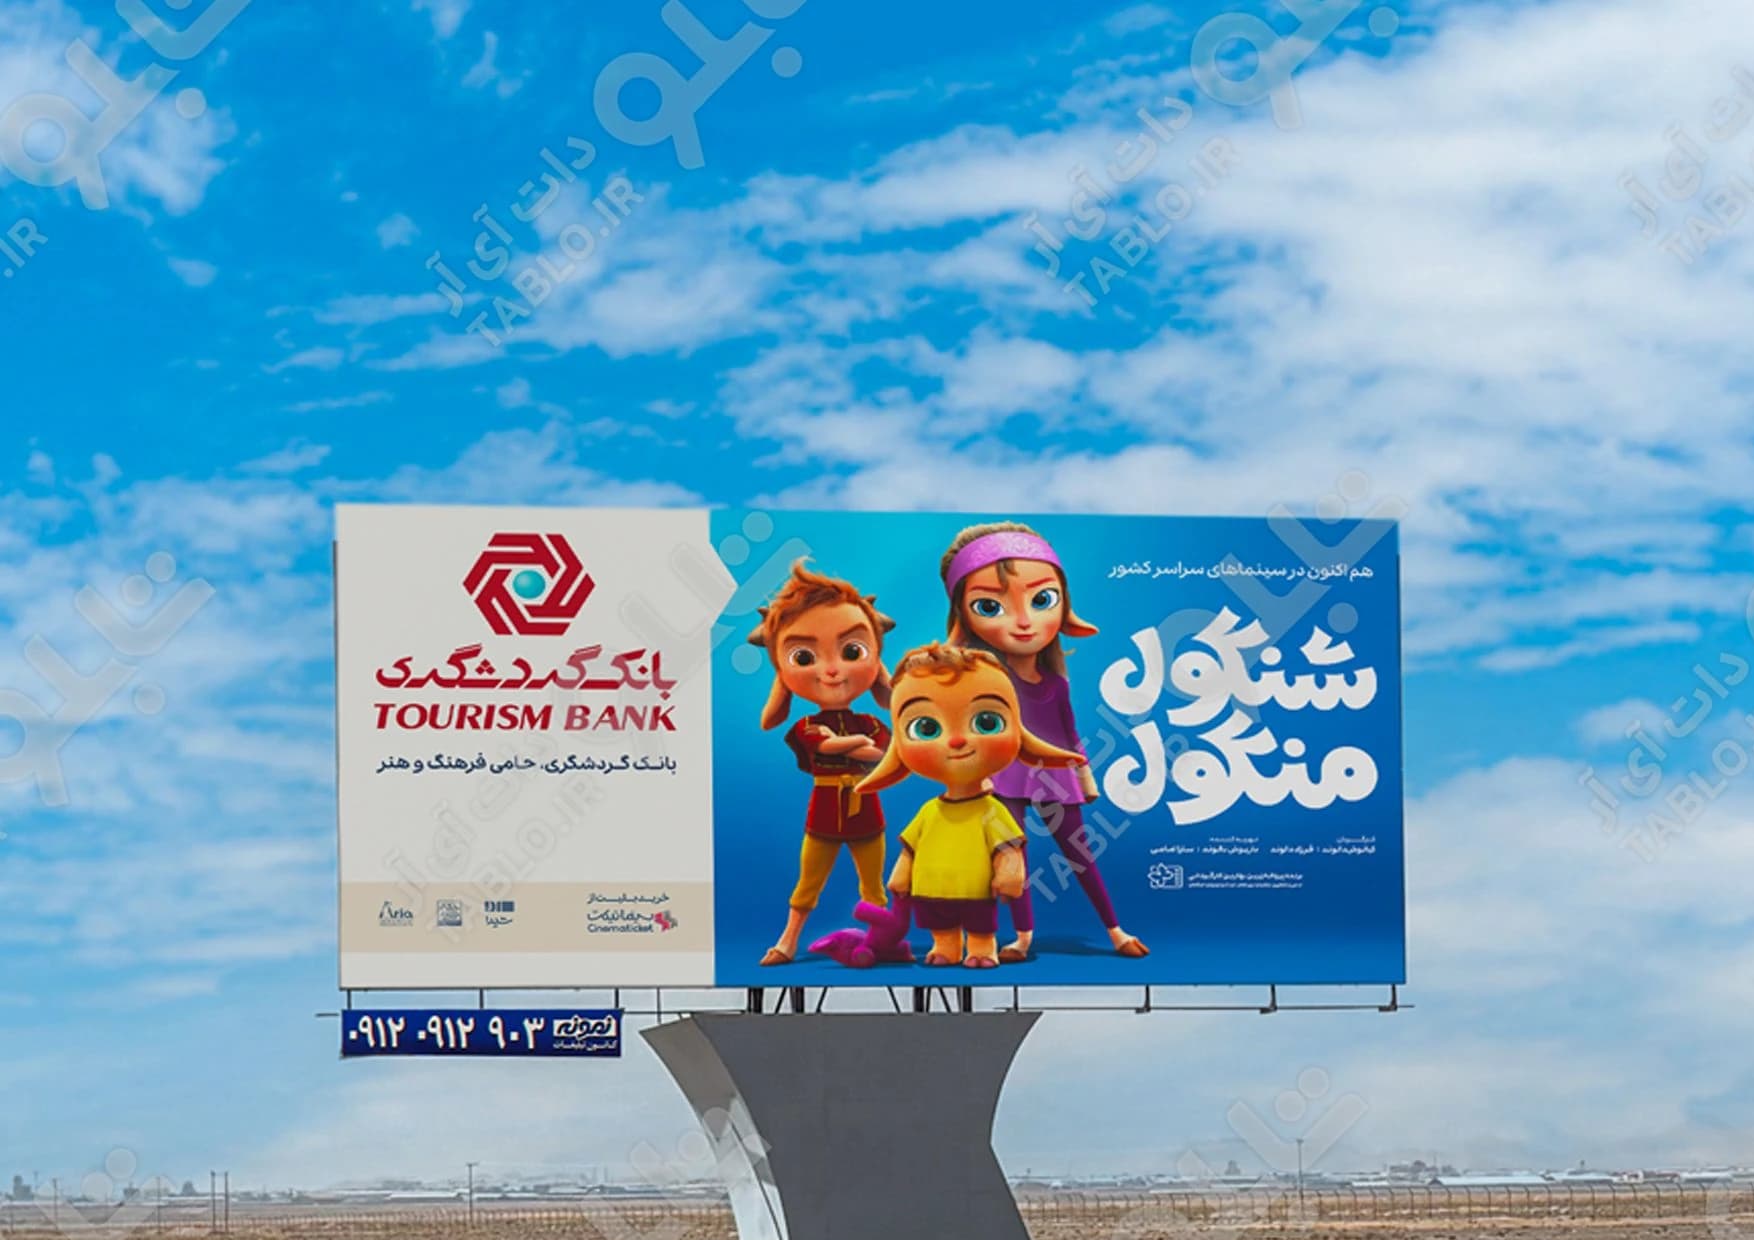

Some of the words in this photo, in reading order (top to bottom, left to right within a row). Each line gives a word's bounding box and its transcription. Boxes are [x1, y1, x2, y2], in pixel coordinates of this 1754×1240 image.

[1107, 560, 1151, 579] کشور
[1153, 561, 1204, 580] سراسر
[1207, 561, 1287, 580] سینماهای
[1287, 565, 1306, 581] در
[1307, 561, 1348, 581] اکنون
[1349, 562, 1374, 581] هم
[376, 643, 602, 690] گردشگری
[579, 648, 678, 700] بانک
[1099, 605, 1378, 727] شنگول
[374, 703, 552, 731] TOURISM
[563, 705, 677, 731] BANK
[376, 755, 410, 773] هنر
[413, 761, 424, 774] و
[426, 752, 486, 774] فرهنگ
[489, 754, 536, 775] حامی
[633, 754, 677, 775] بانک
[1102, 708, 1379, 826] منگول
[349, 1015, 405, 1048] ۰۹۱۲
[417, 1015, 475, 1048] ۰۹۱۲
[488, 1016, 545, 1049] ۹۰۳
[556, 1016, 613, 1039] نمونه
